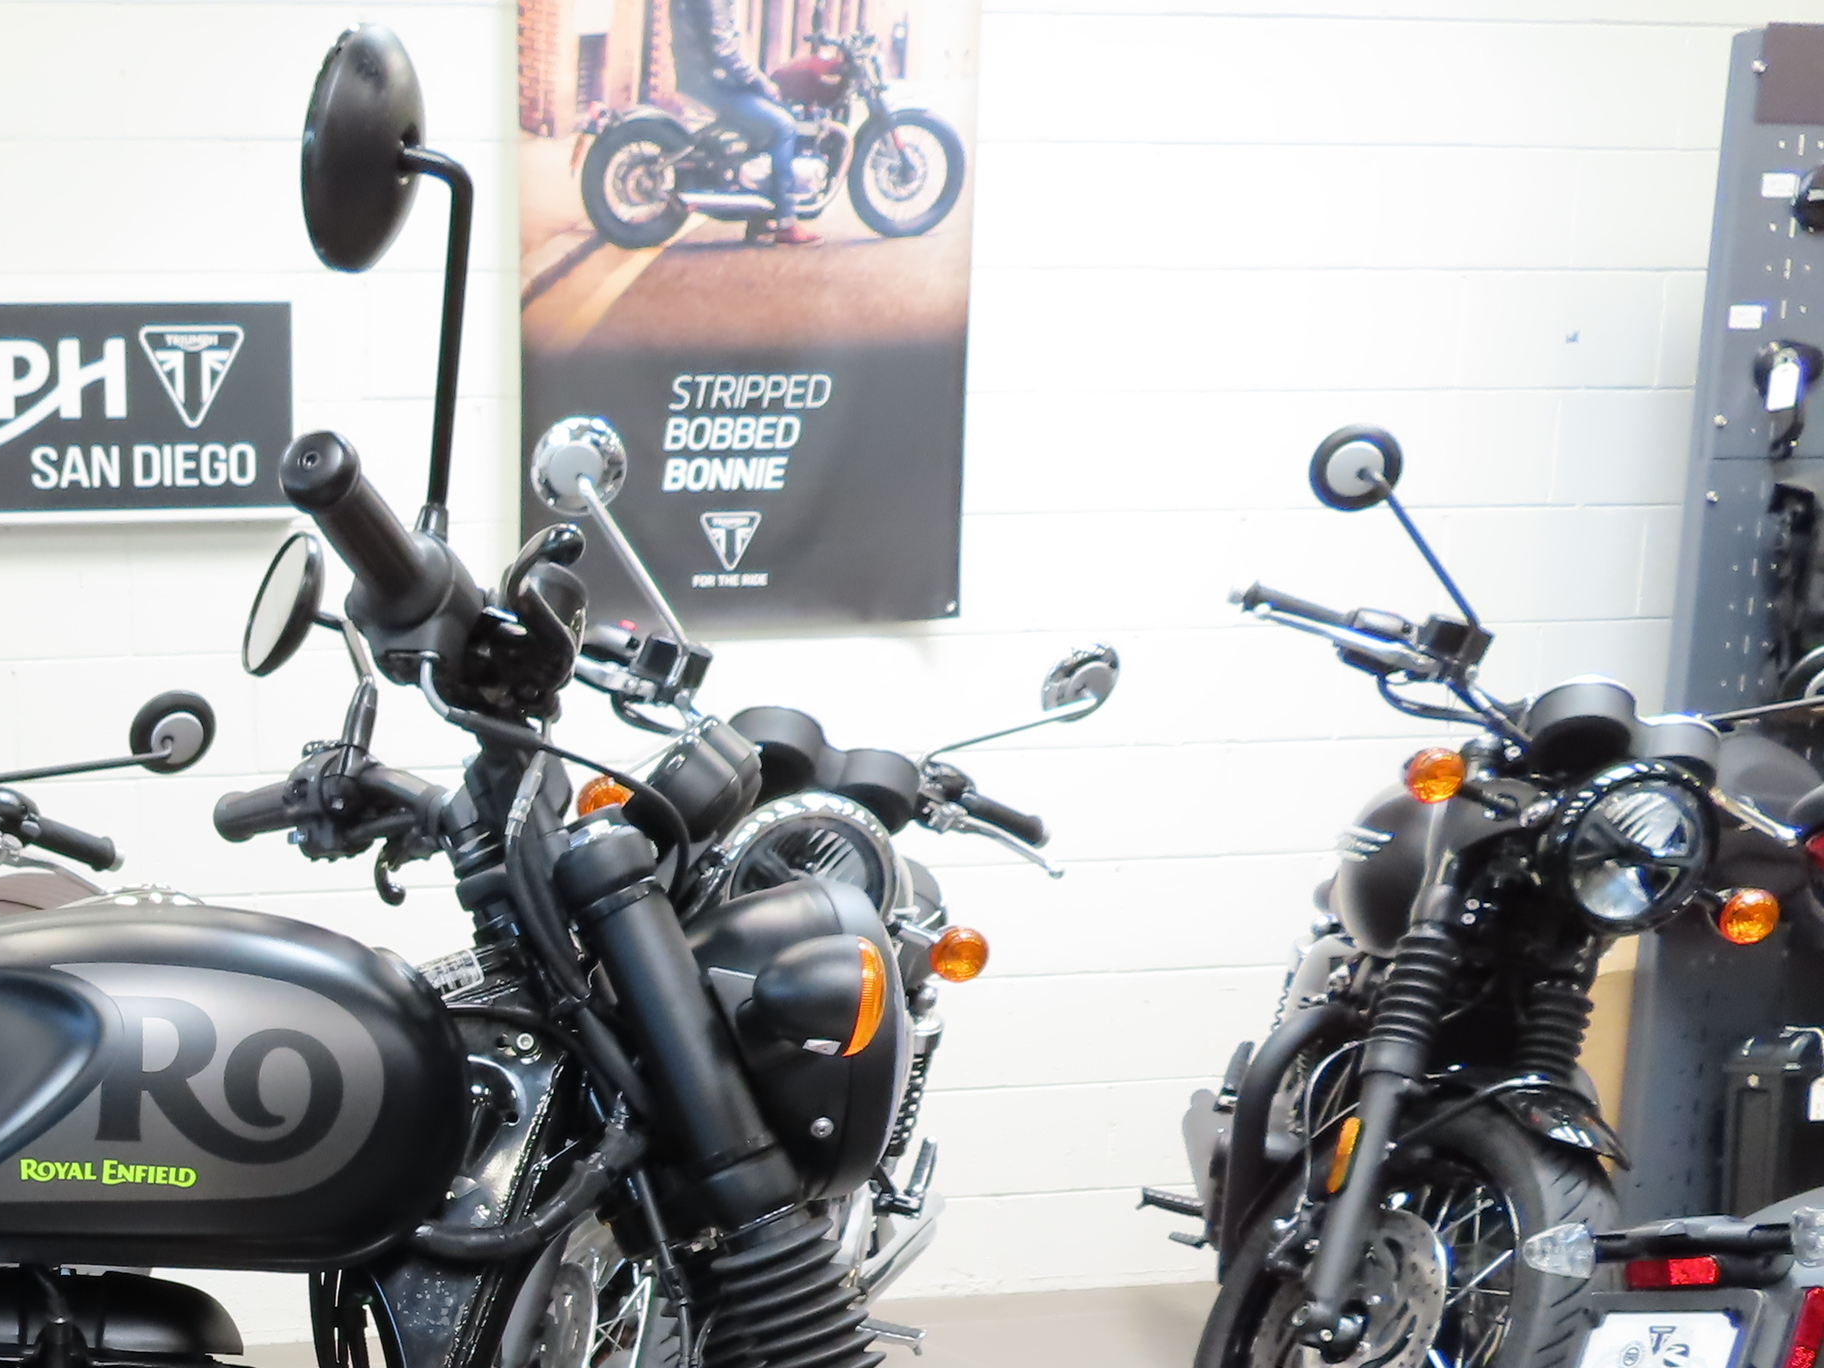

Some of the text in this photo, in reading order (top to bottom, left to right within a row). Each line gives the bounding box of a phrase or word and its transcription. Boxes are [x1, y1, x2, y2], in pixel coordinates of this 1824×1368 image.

[668, 373, 832, 411] STRIPPED
[663, 416, 801, 451] BOBBED
[30, 442, 258, 490] SAN DIEGO
[661, 456, 789, 493] BONNIE
[692, 573, 769, 588] FOR THE RIDE
[20, 1158, 197, 1188] ROYAL ENFIELD
